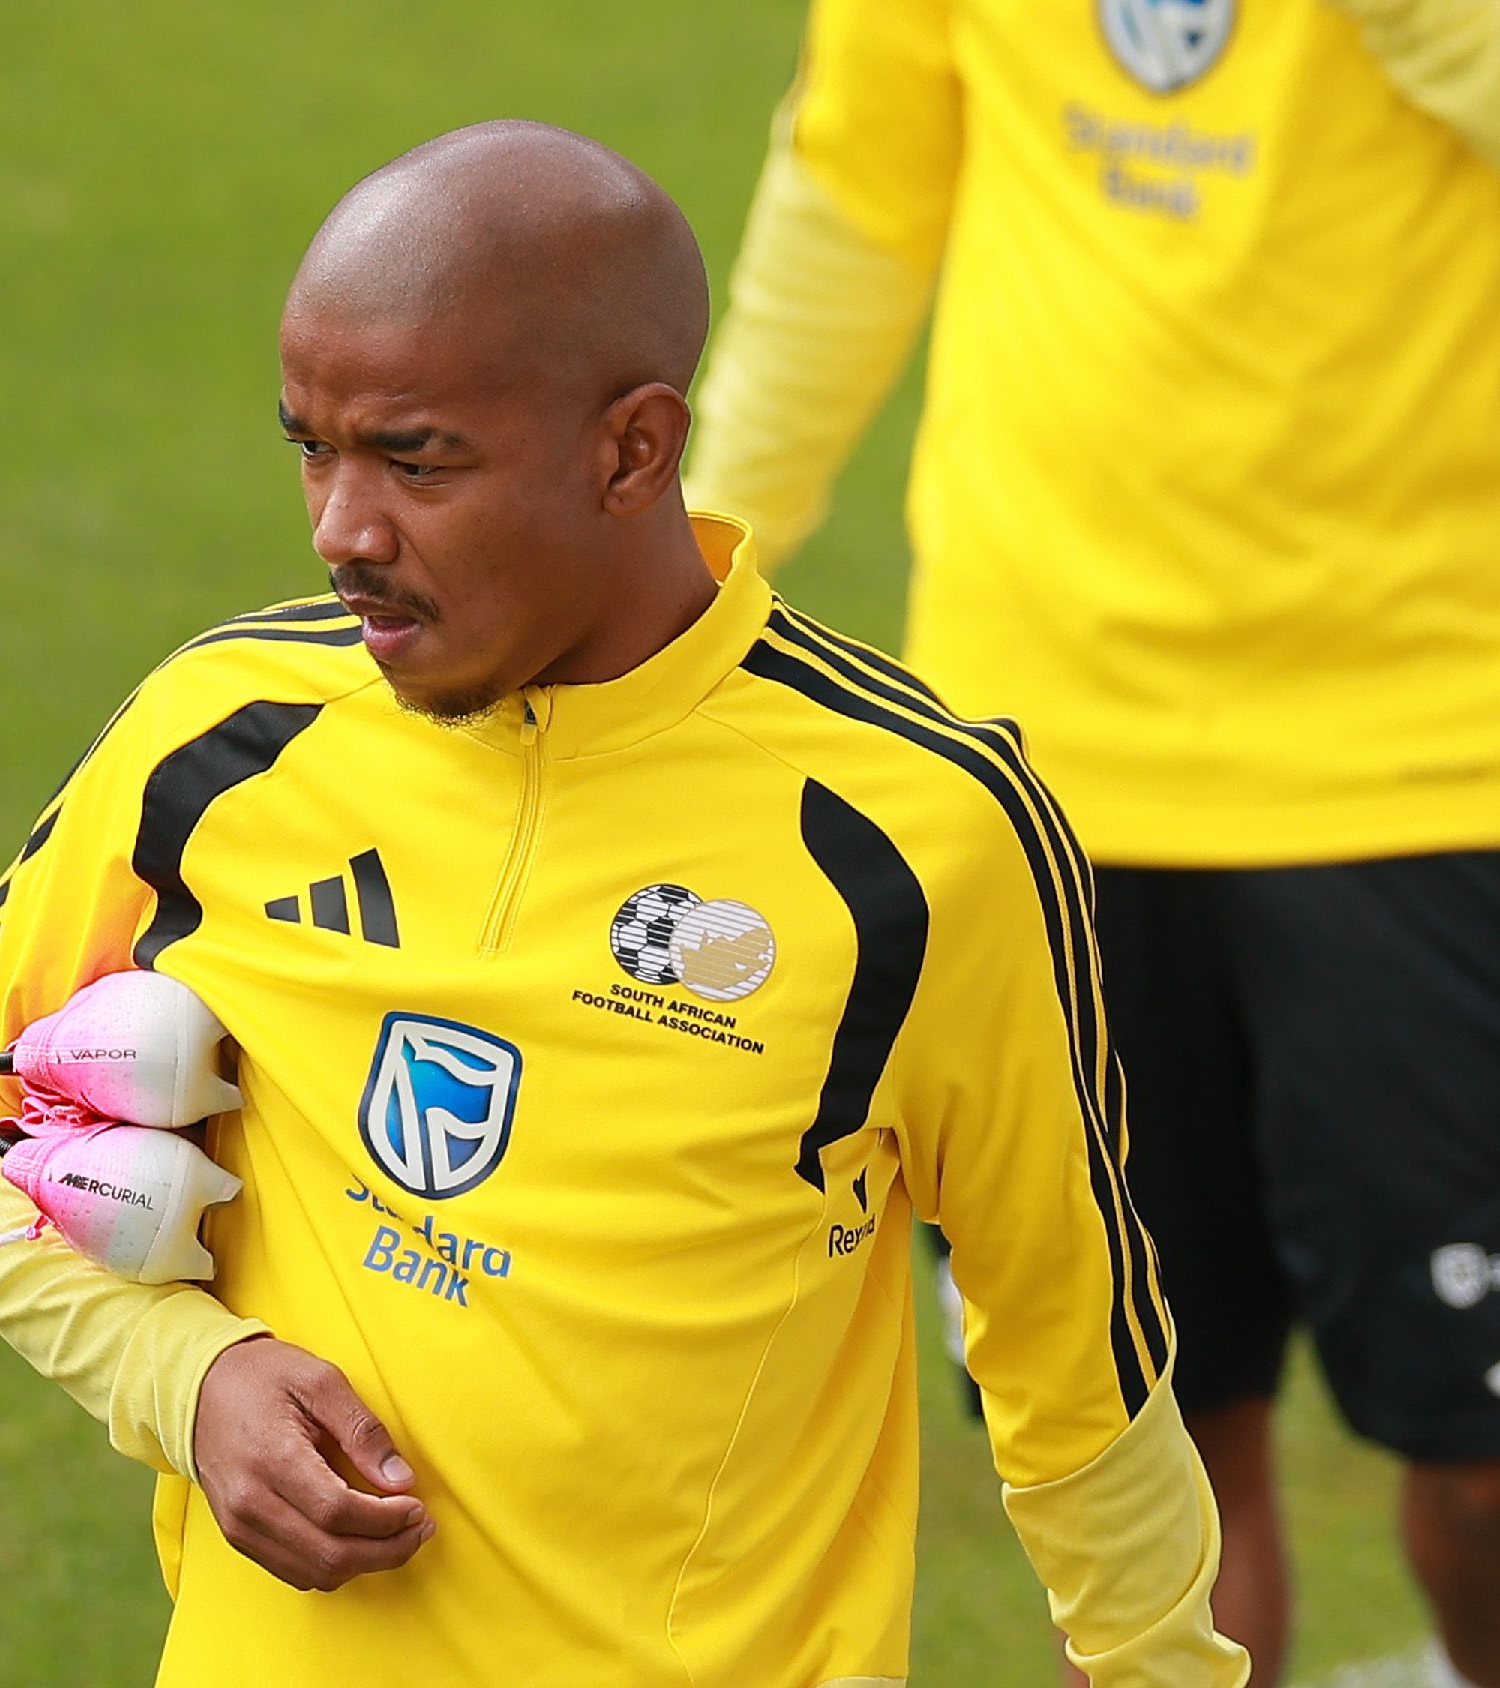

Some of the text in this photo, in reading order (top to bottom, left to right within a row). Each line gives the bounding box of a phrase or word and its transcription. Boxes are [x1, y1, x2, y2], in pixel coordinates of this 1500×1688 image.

[572, 990, 764, 1055] FOOTBALL ASSOCIATION
[610, 983, 737, 1029] SOUTH AFRICAN
[70, 1049, 137, 1060] VAPOR
[58, 1173, 154, 1211] MERCURIAL
[362, 1225, 469, 1307] Bank
